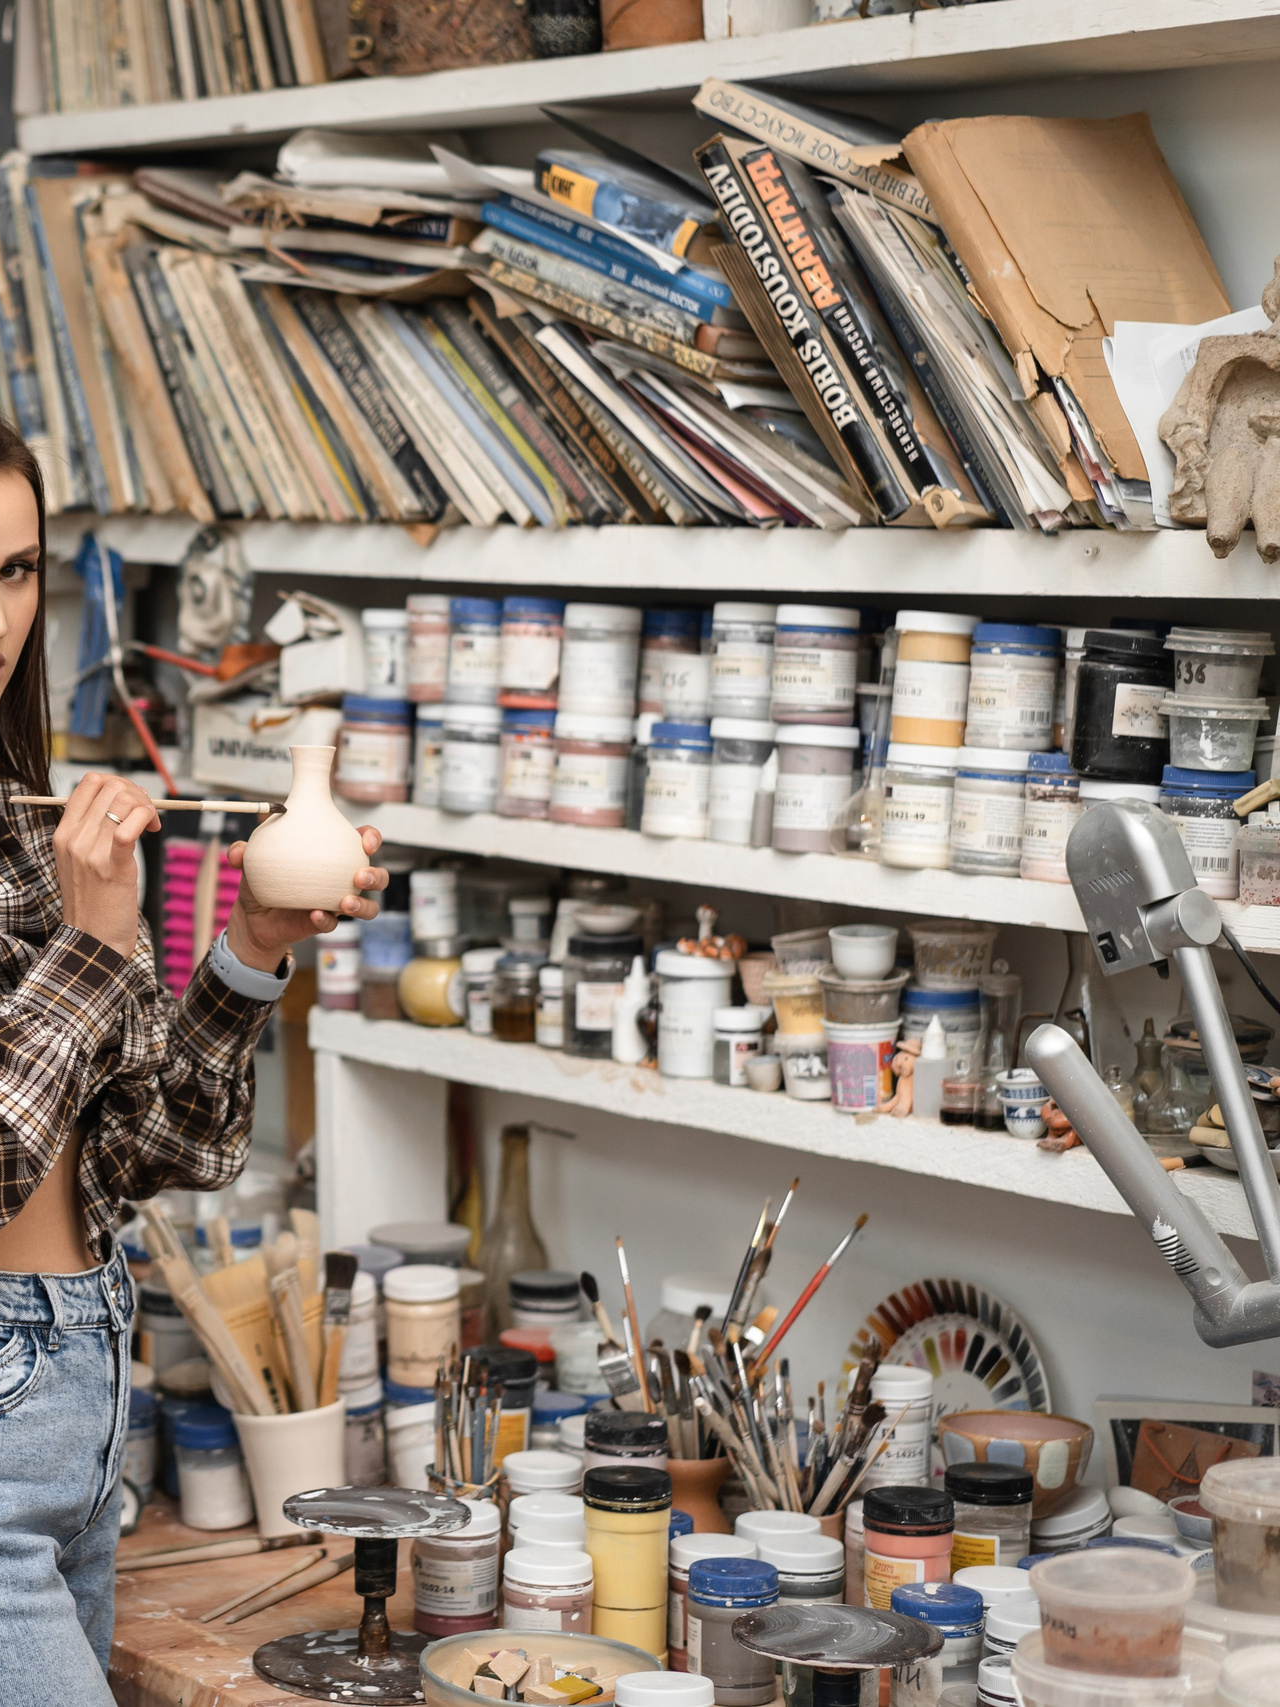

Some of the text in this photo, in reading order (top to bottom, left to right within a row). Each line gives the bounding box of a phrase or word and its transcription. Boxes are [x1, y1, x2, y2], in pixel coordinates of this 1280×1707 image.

[709, 89, 809, 150] ИСКУССТВО
[745, 152, 842, 311] АВАНГАРД
[668, 290, 702, 315] ВОСТОК
[704, 163, 858, 432] BORIS KOUSTODIEV
